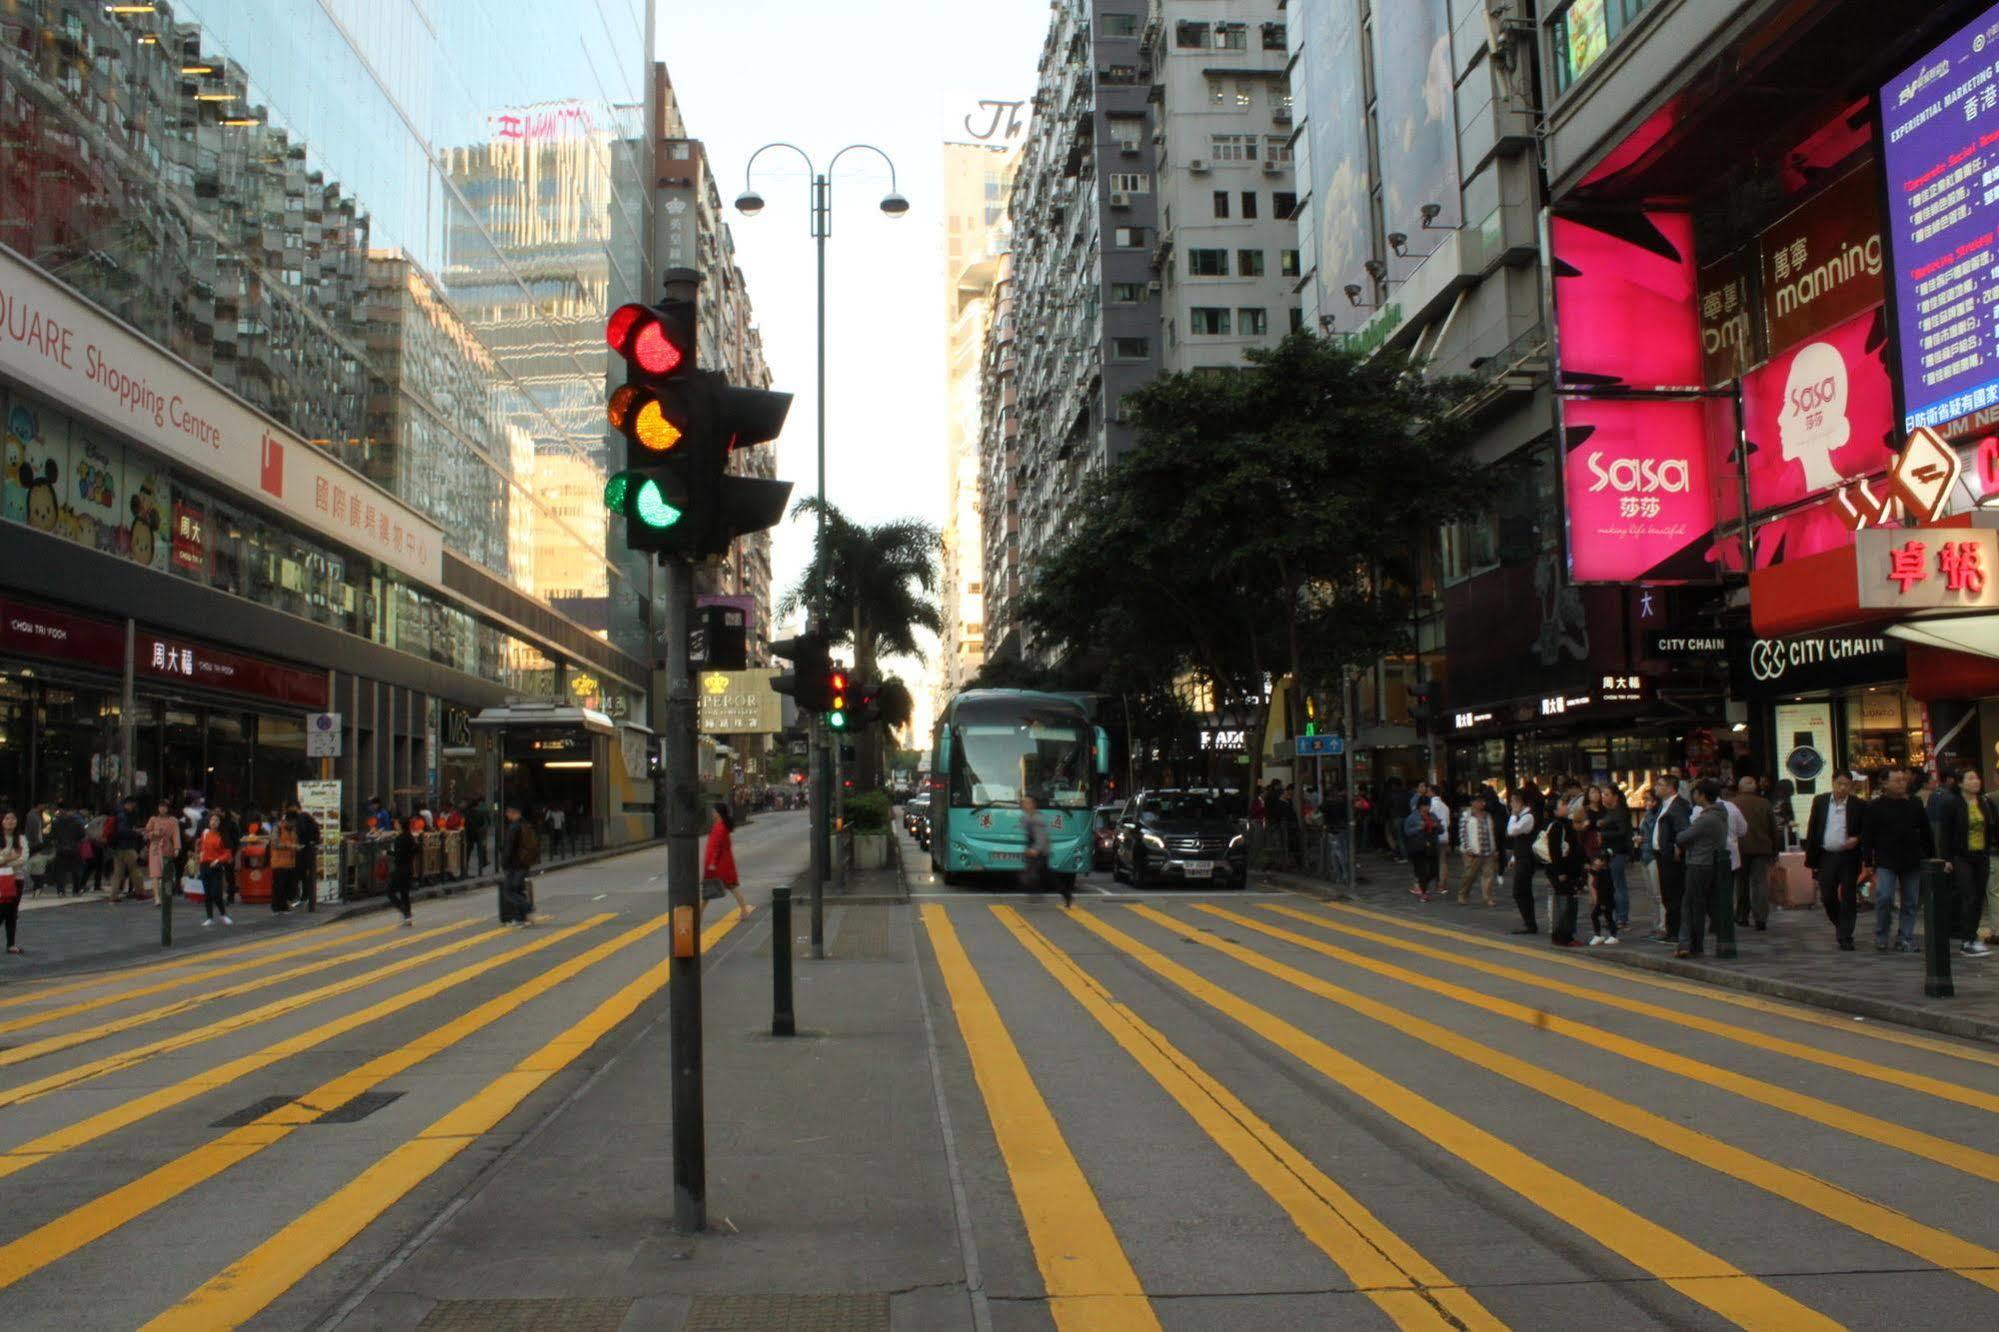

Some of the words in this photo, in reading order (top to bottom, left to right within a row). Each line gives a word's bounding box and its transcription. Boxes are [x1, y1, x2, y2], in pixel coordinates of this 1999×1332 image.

[1943, 66, 1993, 108] MARKETING
[86, 344, 165, 428] Shopping
[170, 395, 220, 449] Centre
[1620, 497, 1660, 518] 莎莎
[1658, 638, 1685, 651] CITY
[1688, 638, 1725, 651] CHAIN
[1789, 639, 1825, 666] CITY
[1829, 638, 1884, 660] CHAIN
[152, 642, 193, 676] 周大福
[1603, 676, 1641, 689] 周大福
